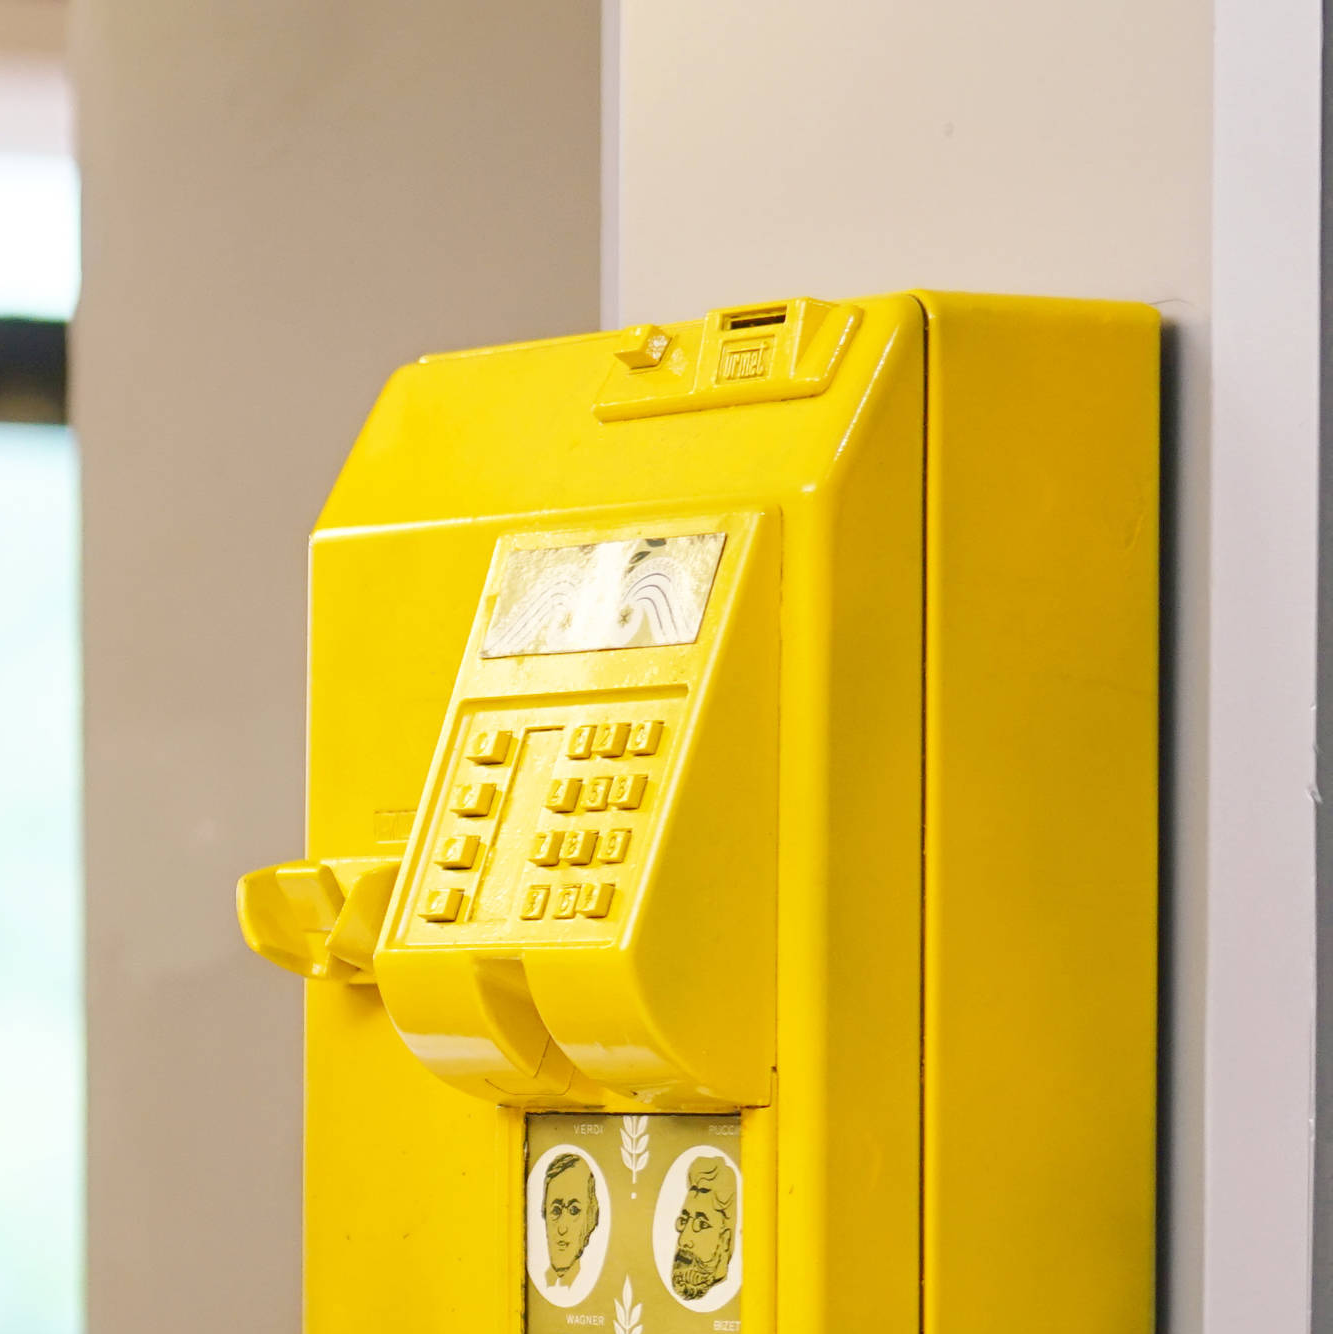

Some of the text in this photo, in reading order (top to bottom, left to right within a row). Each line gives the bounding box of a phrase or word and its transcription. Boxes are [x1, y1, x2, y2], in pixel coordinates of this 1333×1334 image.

[573, 1123, 604, 1136] VERDI
[566, 1313, 605, 1327] WAGNER
[713, 1319, 741, 1332] BIZET
